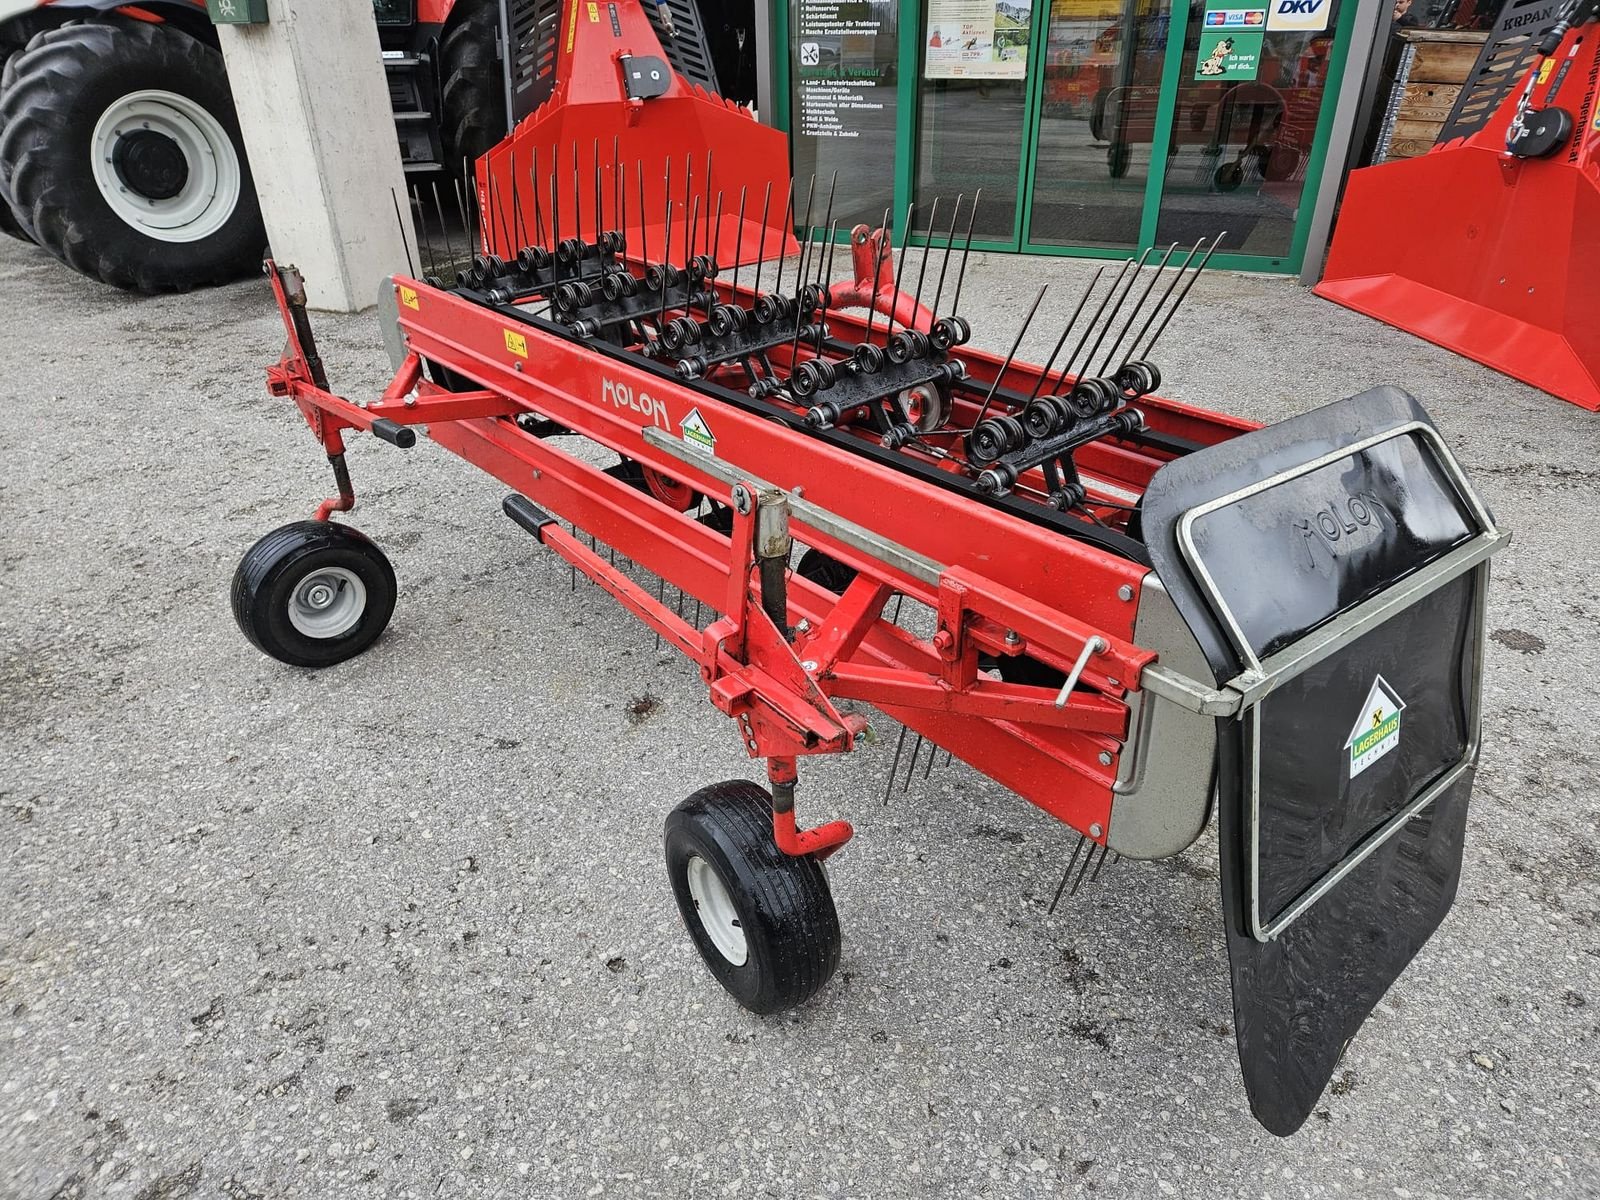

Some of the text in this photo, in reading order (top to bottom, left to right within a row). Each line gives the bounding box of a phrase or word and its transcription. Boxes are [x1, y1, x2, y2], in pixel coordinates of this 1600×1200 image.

[1278, 0, 1322, 14] DKV
[1503, 6, 1554, 31] KRPAN
[848, 68, 880, 77] Verkauf
[602, 376, 671, 432] MOLON
[685, 429, 712, 446] LAGERHAUS
[1293, 489, 1398, 568] MOLON
[1354, 718, 1398, 756] LAGERHAUS
[1353, 736, 1397, 770] TECHNIK
